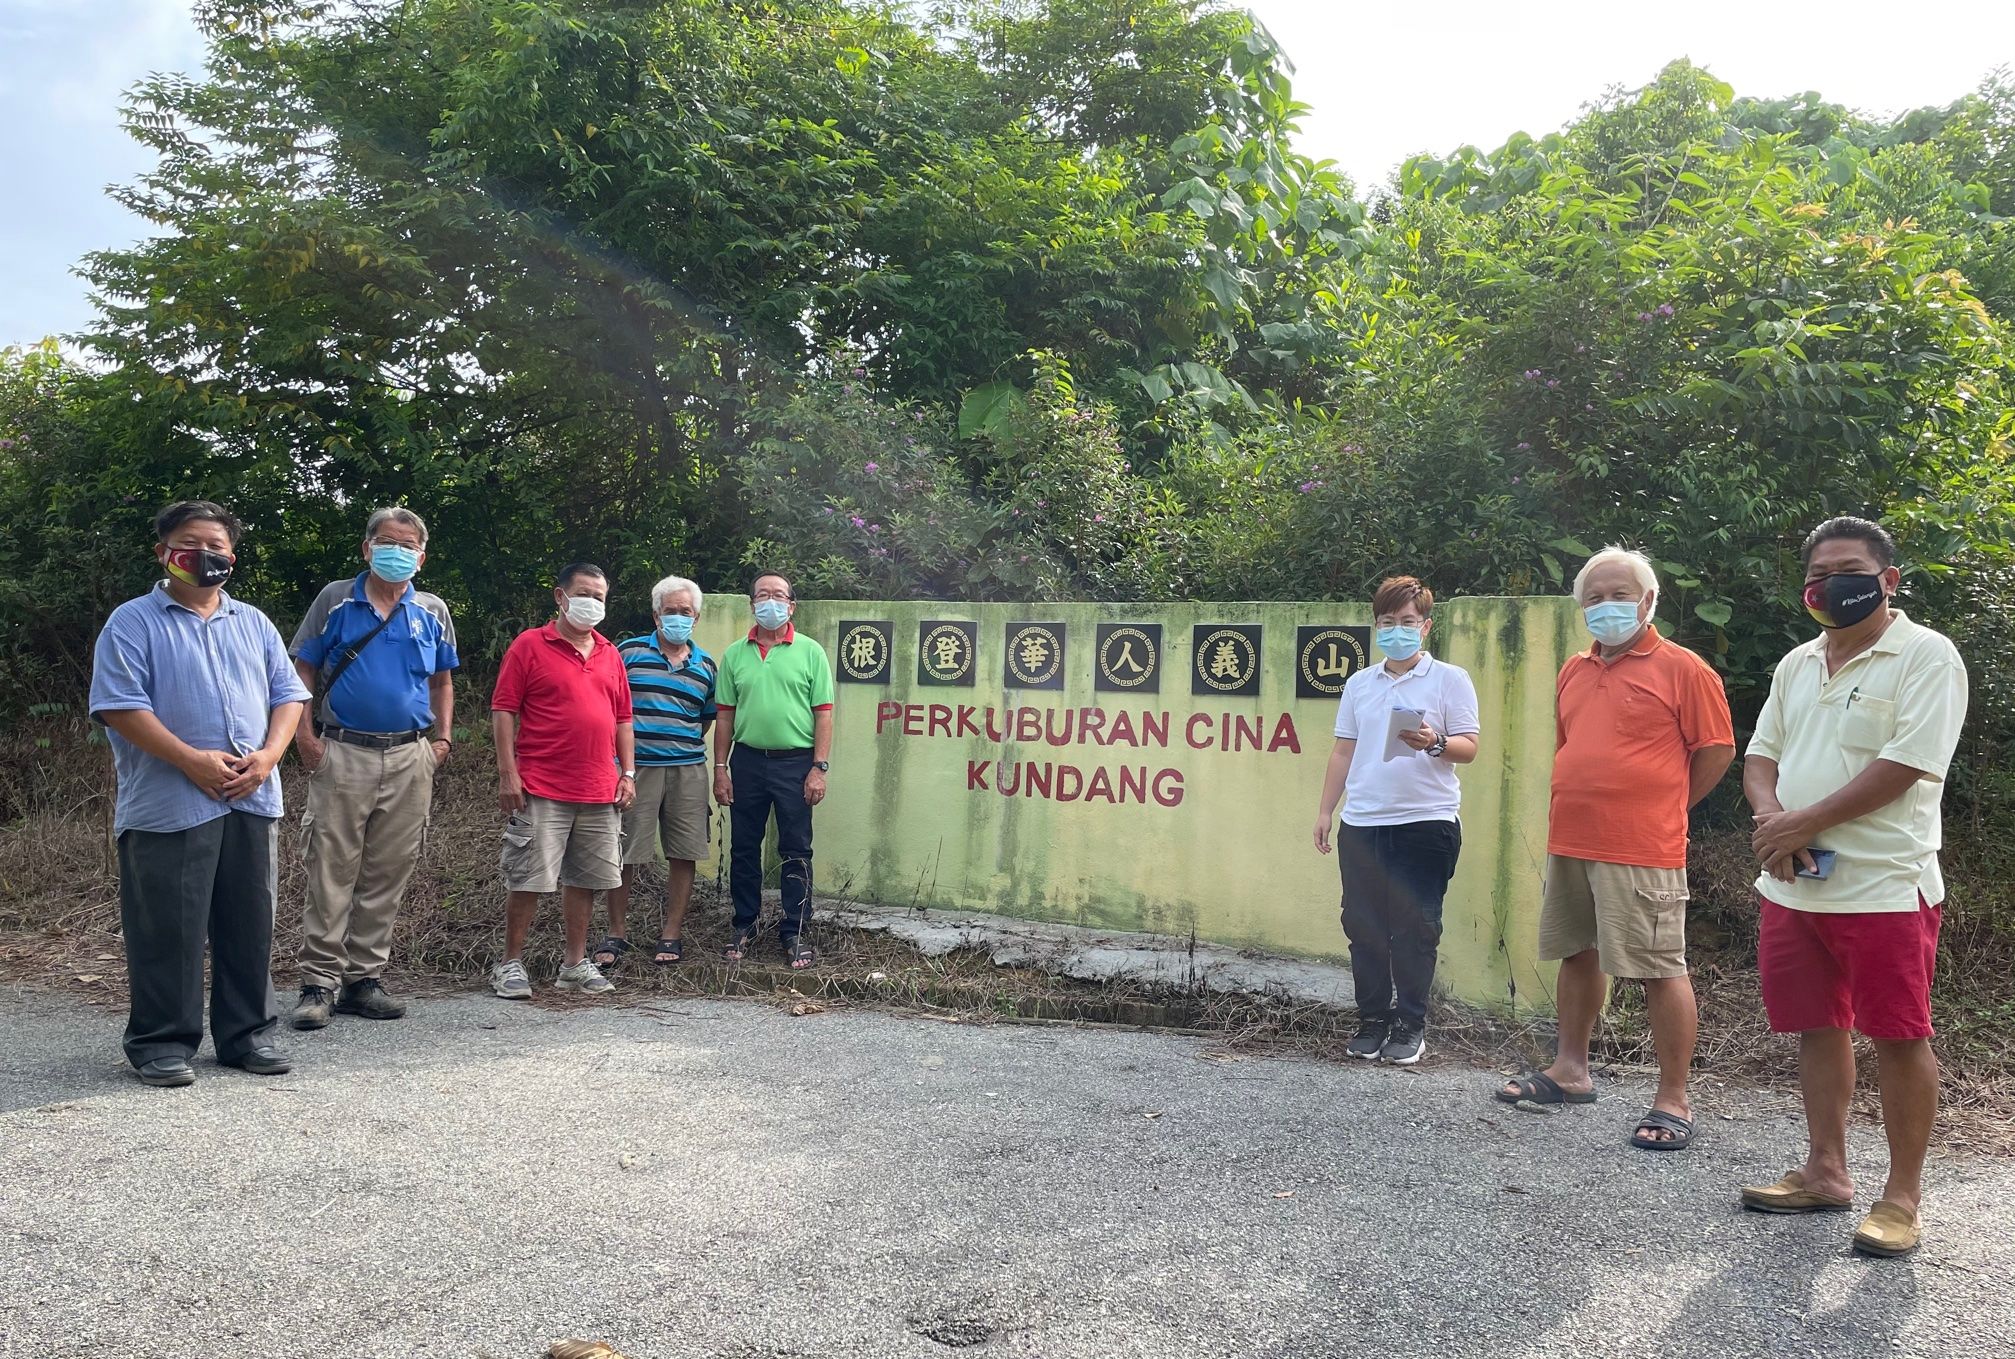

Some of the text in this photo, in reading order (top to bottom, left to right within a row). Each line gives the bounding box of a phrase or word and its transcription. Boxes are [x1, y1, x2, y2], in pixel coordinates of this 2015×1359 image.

[876, 701, 1302, 754] PERKUBURAN CINA
[967, 760, 1185, 808] KUNDANG
